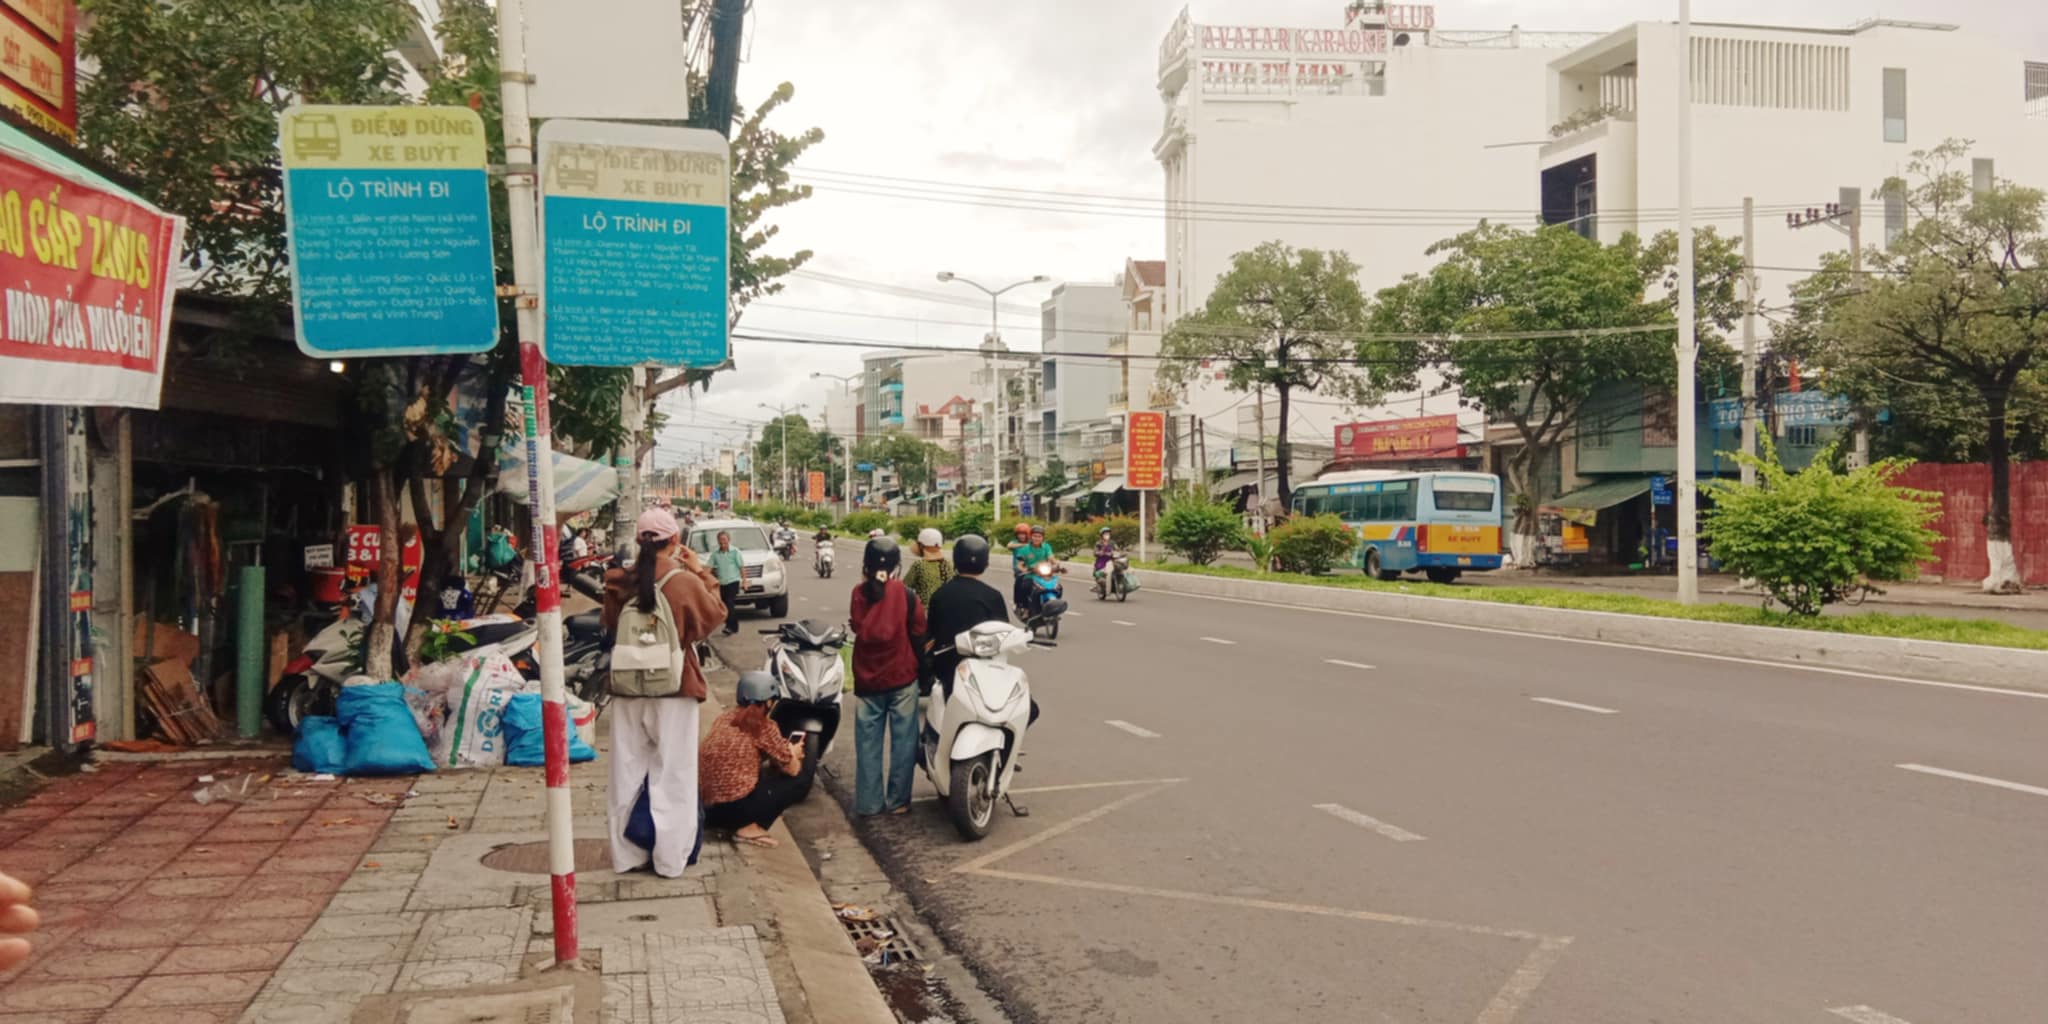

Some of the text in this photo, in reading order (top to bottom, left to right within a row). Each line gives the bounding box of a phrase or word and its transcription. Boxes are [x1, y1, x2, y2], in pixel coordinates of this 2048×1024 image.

[1387, 5, 1434, 29] CLUB
[1202, 26, 1289, 50] AVATAR
[1295, 29, 1387, 54] KARAOKE
[351, 111, 474, 138] ĐIỂM DỪNG
[367, 144, 461, 161] XE BUÝT
[327, 177, 449, 201] LỘ TRÌNH ĐI
[621, 179, 704, 198] XE BUÝT
[29, 184, 83, 271] CẤP
[583, 211, 692, 235] LỘ TRÌNH ĐI
[6, 280, 49, 346] MÒN
[53, 284, 87, 351] CỦA
